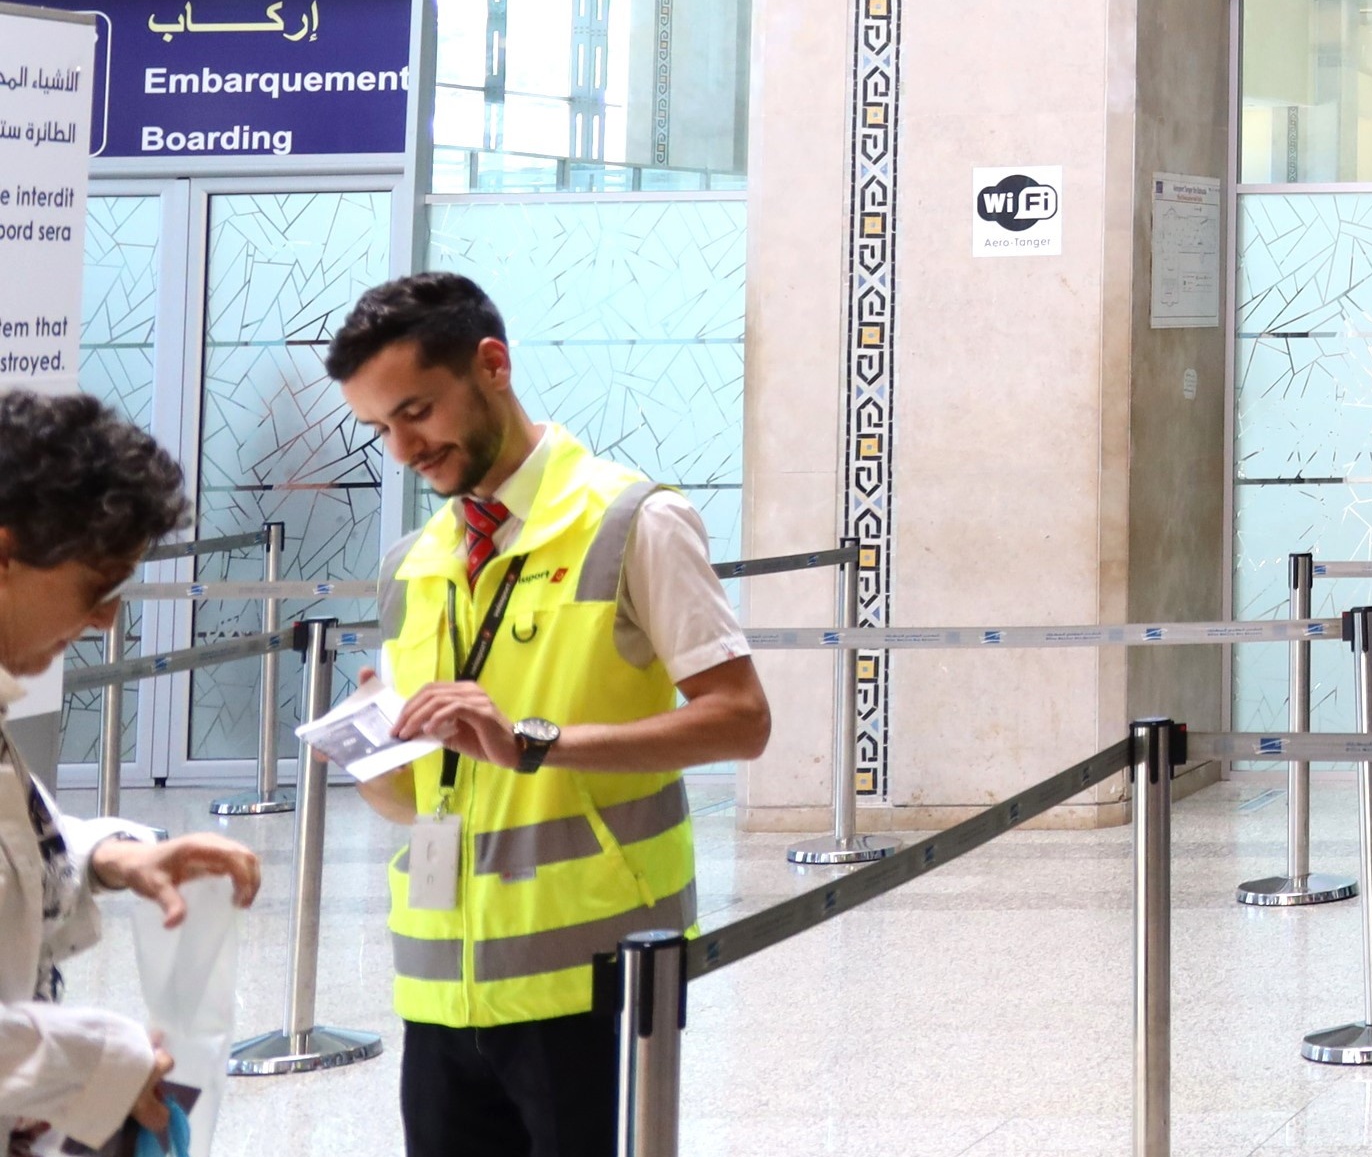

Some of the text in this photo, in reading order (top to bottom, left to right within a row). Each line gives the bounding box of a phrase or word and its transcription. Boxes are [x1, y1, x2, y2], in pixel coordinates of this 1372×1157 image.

[148, 0, 320, 42] إركاب
[144, 67, 410, 98] Embarquement
[25, 121, 76, 147] الطائرة
[141, 126, 293, 155] Boarding
[16, 186, 74, 208] interdit
[38, 224, 71, 241] sera
[0, 316, 68, 338] em that
[0, 351, 65, 376] stroyed.
